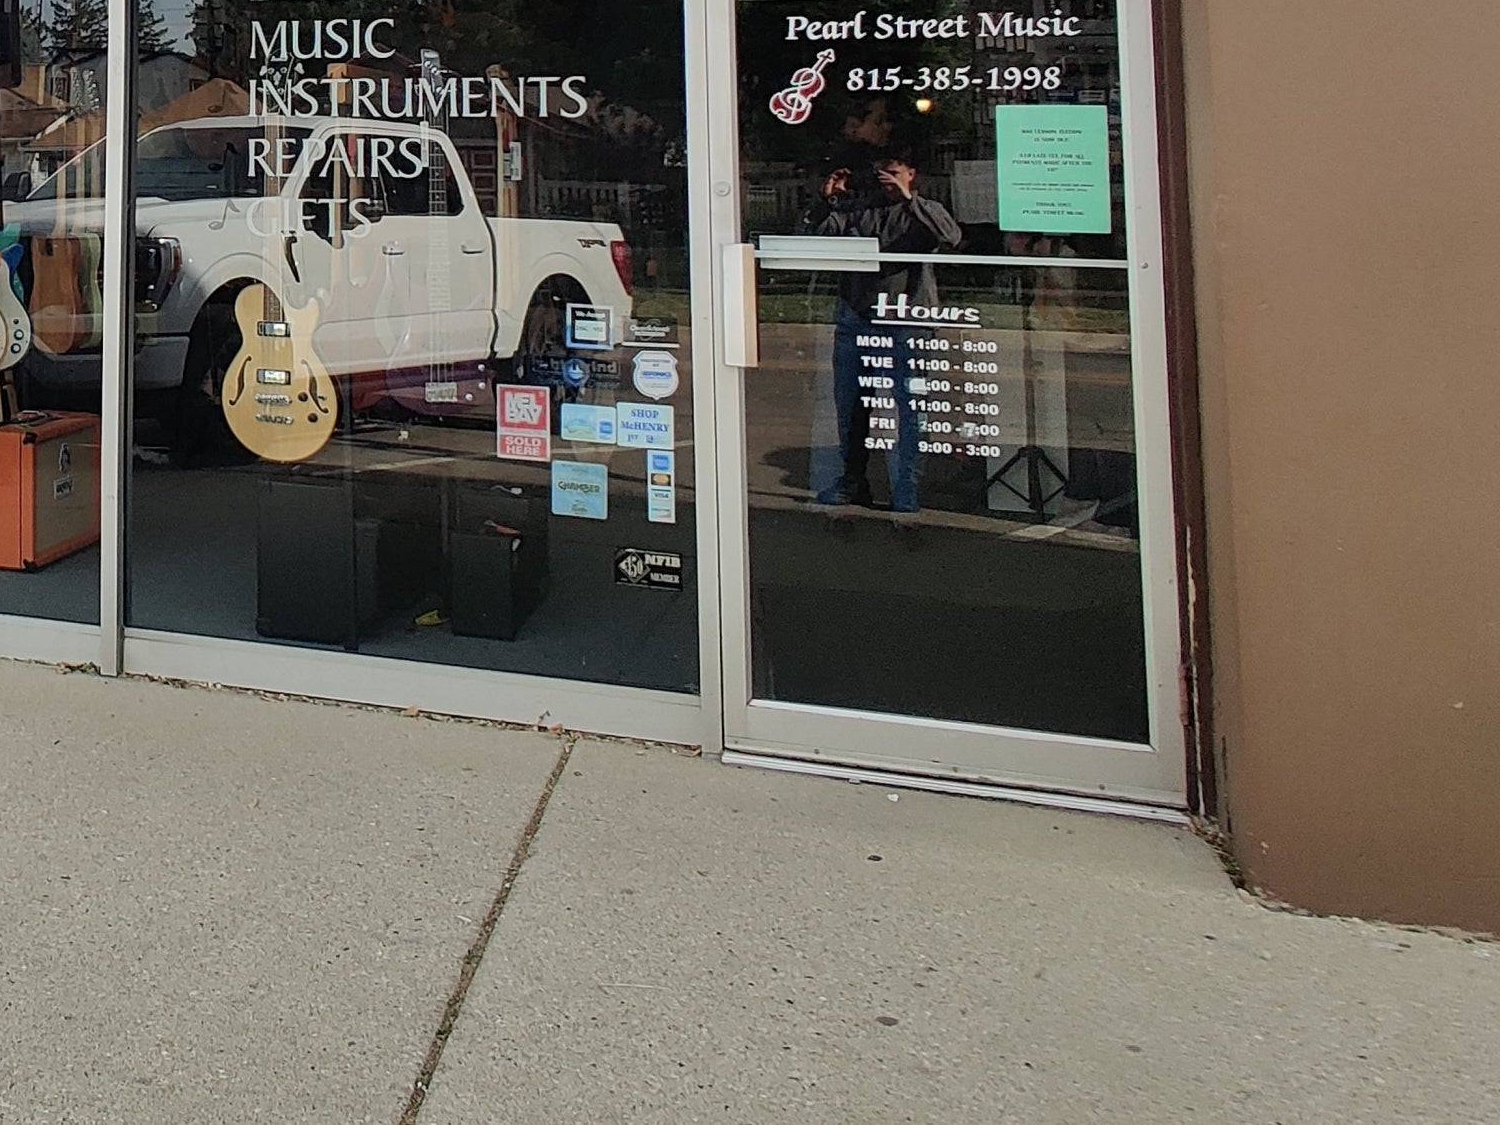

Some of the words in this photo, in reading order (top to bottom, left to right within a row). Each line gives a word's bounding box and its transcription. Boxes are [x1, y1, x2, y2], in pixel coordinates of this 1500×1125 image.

[785, 11, 866, 41] Pearl
[875, 12, 968, 40] Street
[977, 8, 1082, 38] Music
[249, 18, 396, 60] MUSIC
[846, 65, 1061, 92] 815-385-1998
[248, 75, 588, 119] INSTRUMENTS
[247, 137, 424, 178] REPAIRS
[245, 197, 371, 239] GIFTS
[871, 292, 980, 322] Hours
[856, 335, 893, 348] MON
[906, 337, 949, 351] 11:00
[962, 341, 997, 353] 8:00
[861, 356, 894, 368] TUE
[907, 358, 950, 371] 11:00
[963, 361, 998, 374] 8:00
[858, 376, 894, 389] WED
[909, 378, 950, 394] :00
[964, 382, 999, 395] 8:00
[505, 391, 536, 408] MEL
[860, 397, 895, 409] THU
[908, 399, 951, 413] 11:00
[964, 403, 1000, 416] 8:00
[505, 405, 542, 424] BAY
[630, 409, 659, 418] SHOP
[620, 420, 670, 432] McHENRY
[869, 417, 896, 430] FRI
[505, 436, 541, 447] SOLD
[506, 445, 541, 456] HERE
[864, 437, 896, 450] SAT
[918, 441, 952, 454] 9:00
[965, 444, 1001, 457] 3:00
